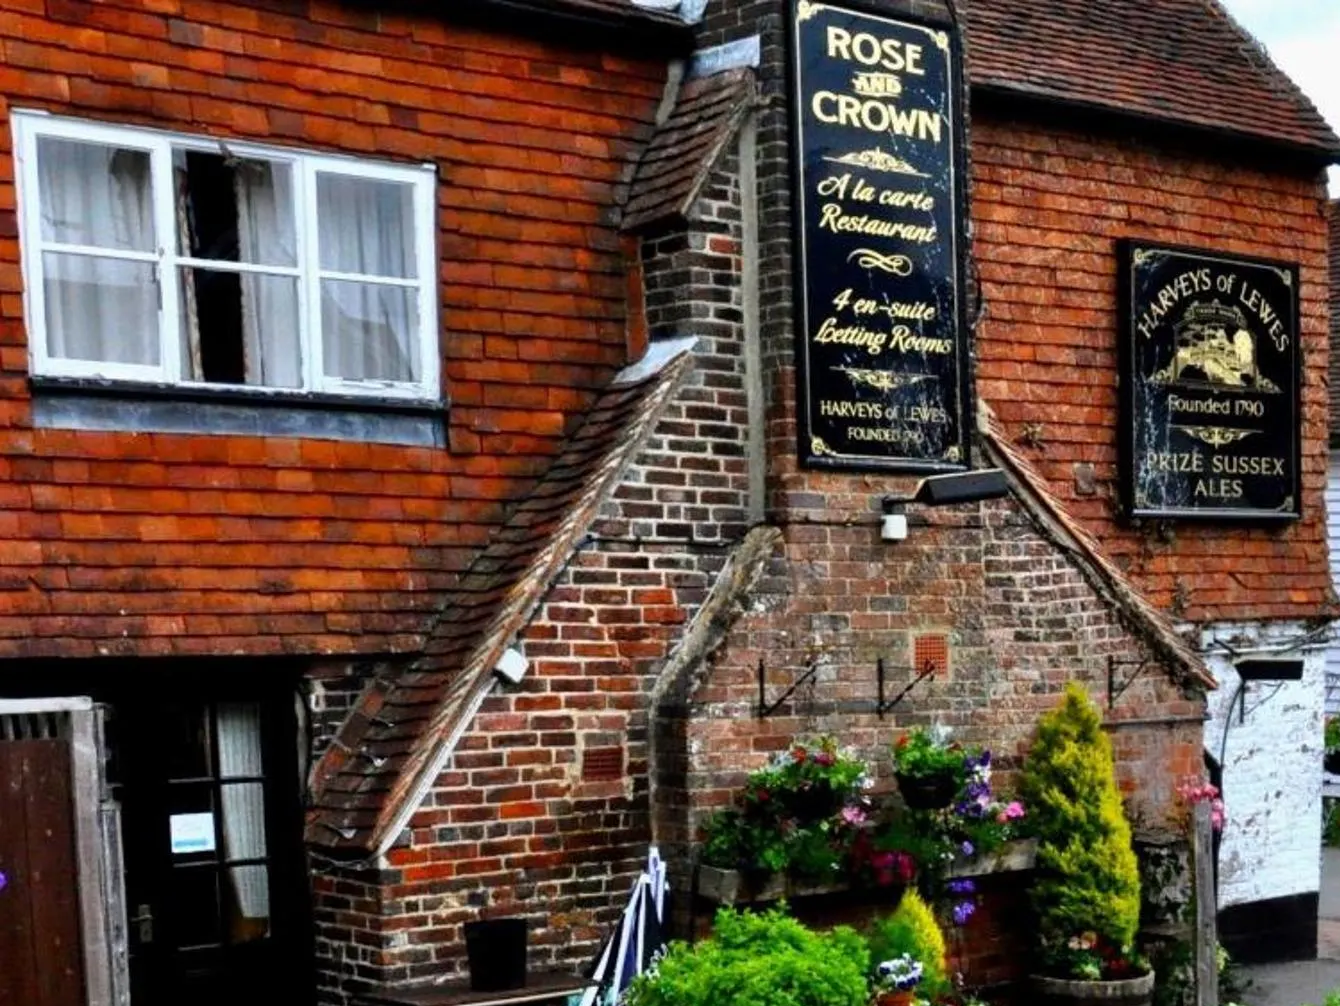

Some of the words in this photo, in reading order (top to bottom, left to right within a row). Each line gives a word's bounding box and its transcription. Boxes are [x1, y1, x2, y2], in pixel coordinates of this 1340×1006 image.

[827, 26, 925, 75] ROSE
[853, 75, 902, 94] AND
[812, 91, 941, 143] CROWN
[817, 173, 851, 199] A
[852, 179, 876, 202] la
[879, 190, 935, 212] carte
[819, 203, 937, 243] Restaurant
[832, 289, 853, 311] 4
[853, 298, 935, 321] en-suite
[1137, 268, 1212, 339] HARVEYS
[1216, 274, 1236, 294] of
[1239, 281, 1289, 352] LEWES
[814, 317, 887, 355] Letting
[889, 325, 952, 353] Rooms
[820, 400, 882, 419] HARVEYS
[903, 405, 946, 423] LEWES
[1168, 394, 1230, 415] Founded
[1235, 400, 1265, 417] 1790
[848, 427, 899, 442] FOUNDED
[1147, 452, 1204, 472] PRIZE
[1212, 455, 1285, 475] SUSSEX
[1194, 480, 1243, 498] ALES
